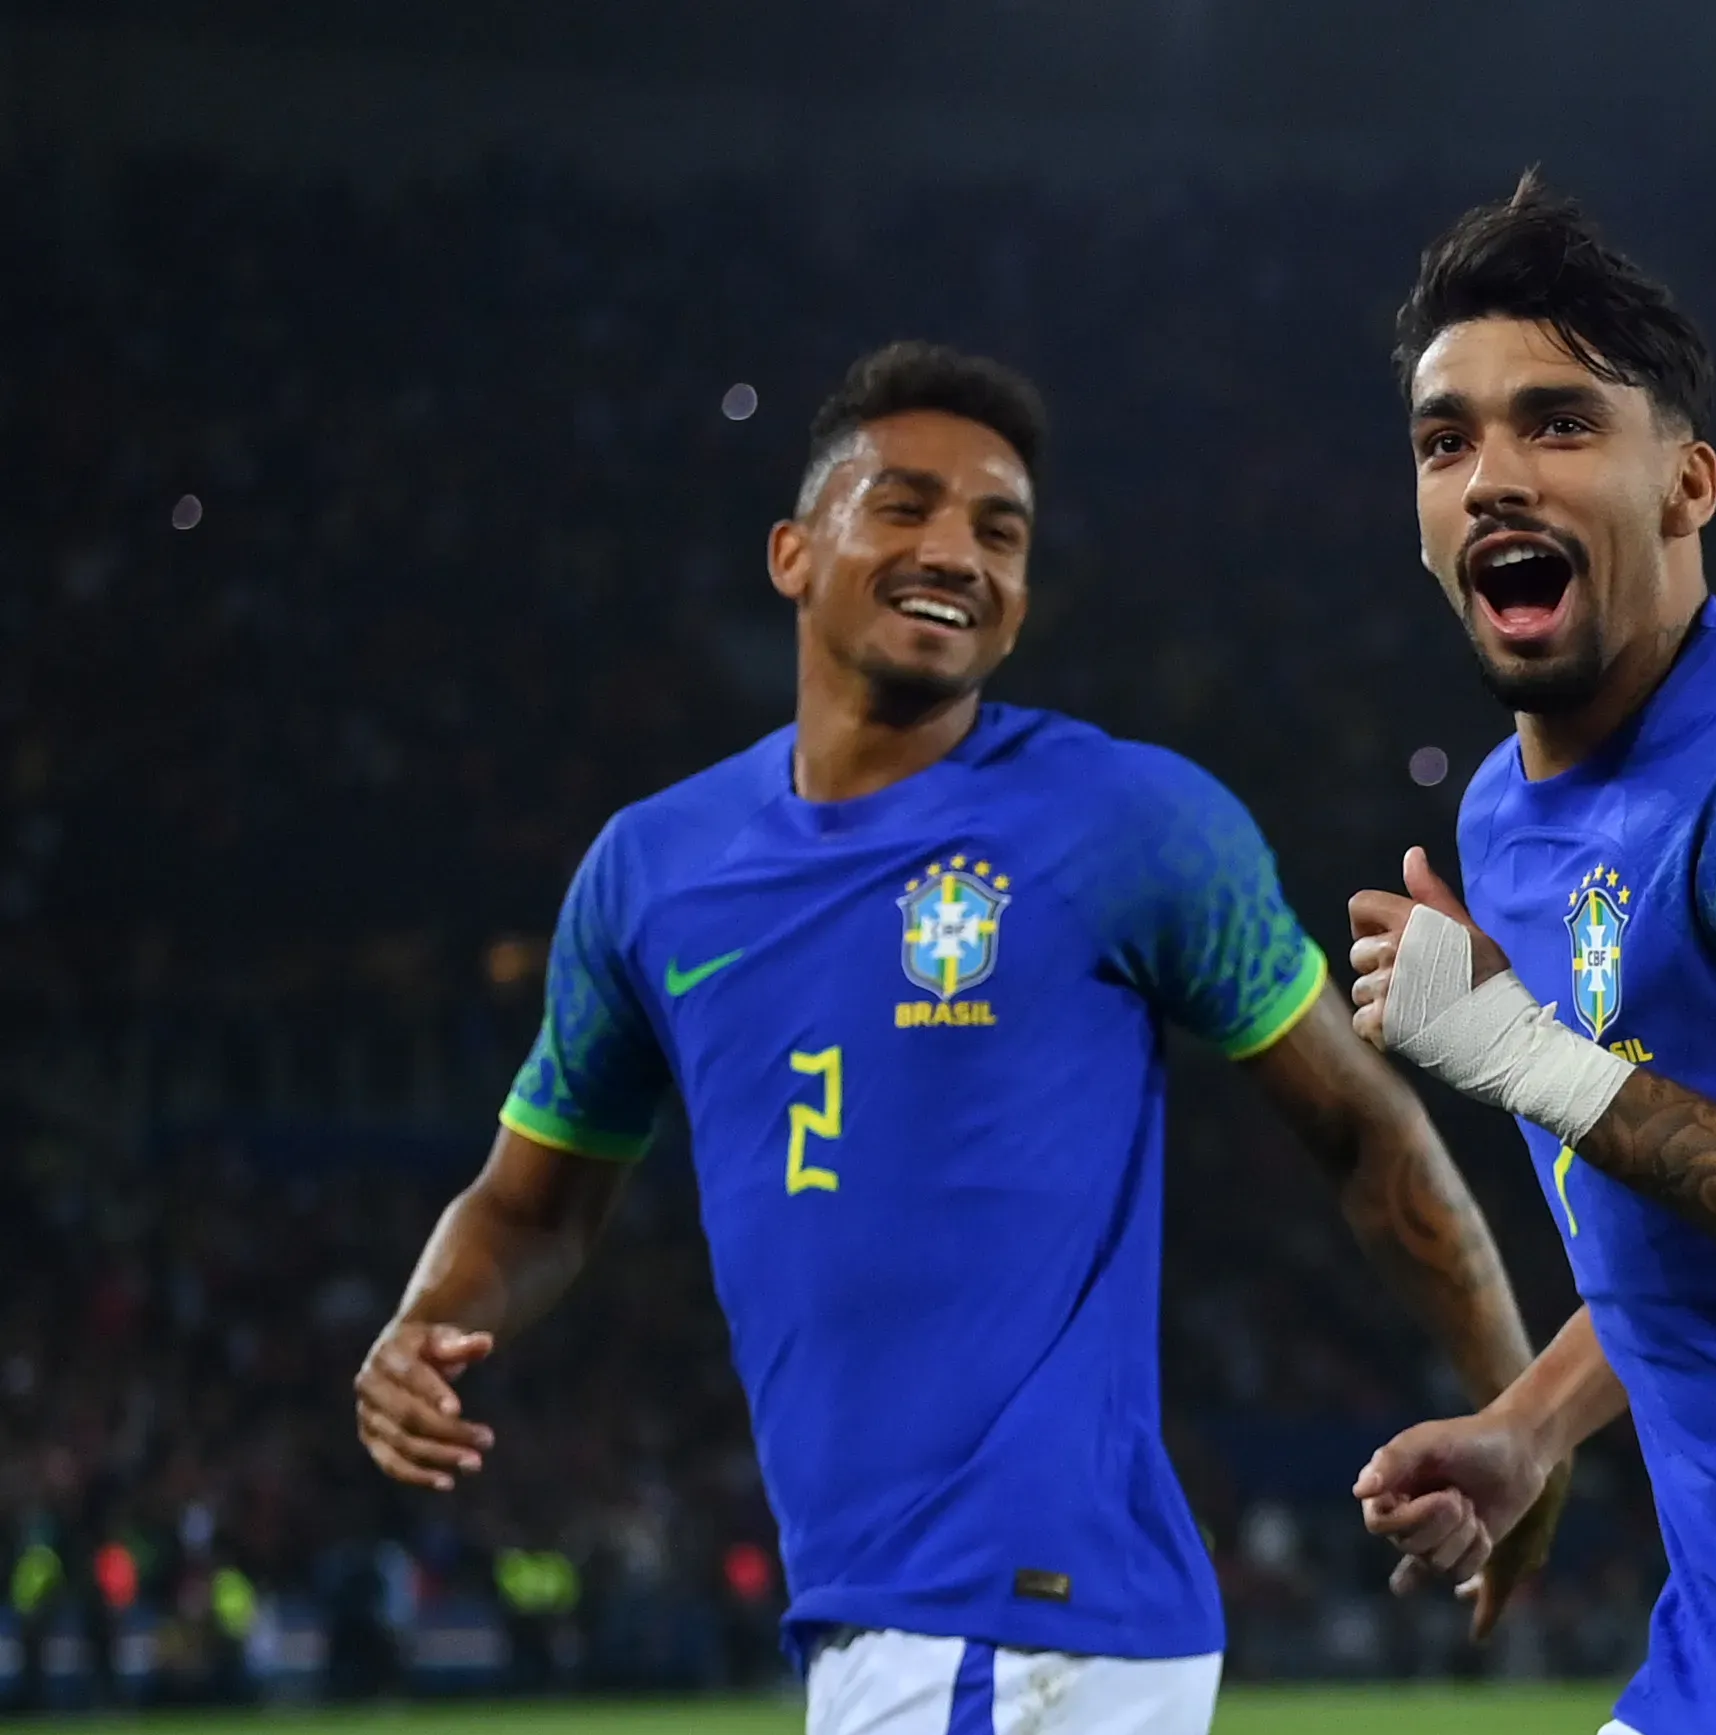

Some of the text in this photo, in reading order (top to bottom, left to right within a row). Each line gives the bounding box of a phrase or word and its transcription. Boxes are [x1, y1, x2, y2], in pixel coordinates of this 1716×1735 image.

[1587, 950, 1606, 966] CBF
[895, 1001, 996, 1029] BRASIL
[786, 1046, 842, 1195] 2
